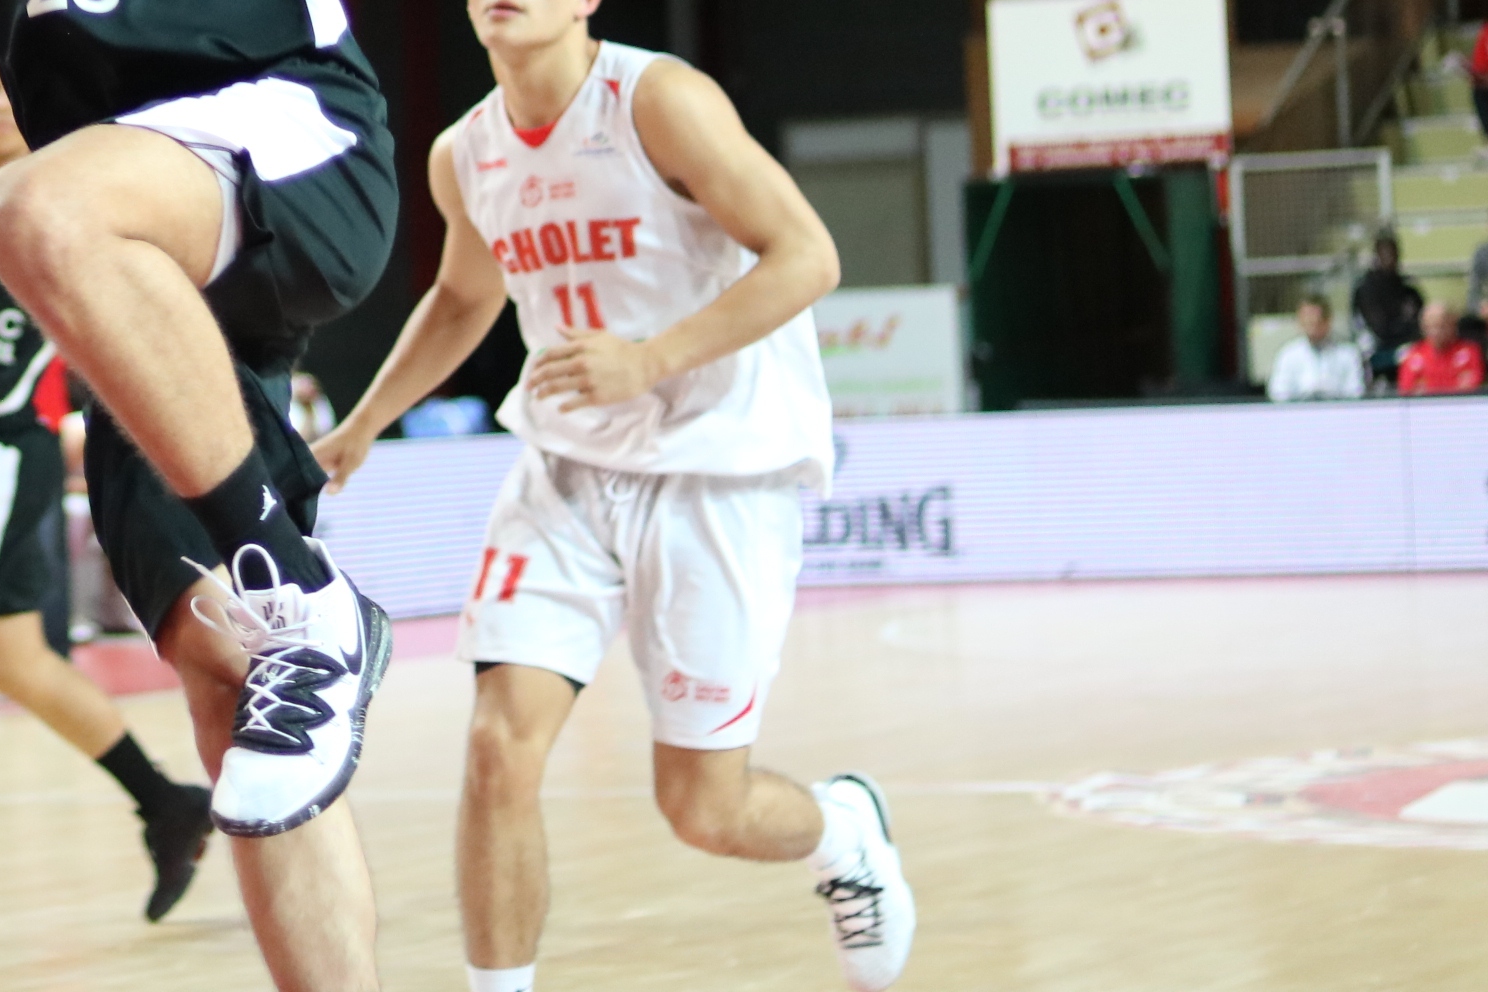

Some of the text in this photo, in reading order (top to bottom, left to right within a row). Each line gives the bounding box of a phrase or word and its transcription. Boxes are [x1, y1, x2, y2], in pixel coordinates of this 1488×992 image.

[492, 218, 641, 275] CHOLET
[553, 281, 605, 330] 11
[472, 547, 530, 603] 11
